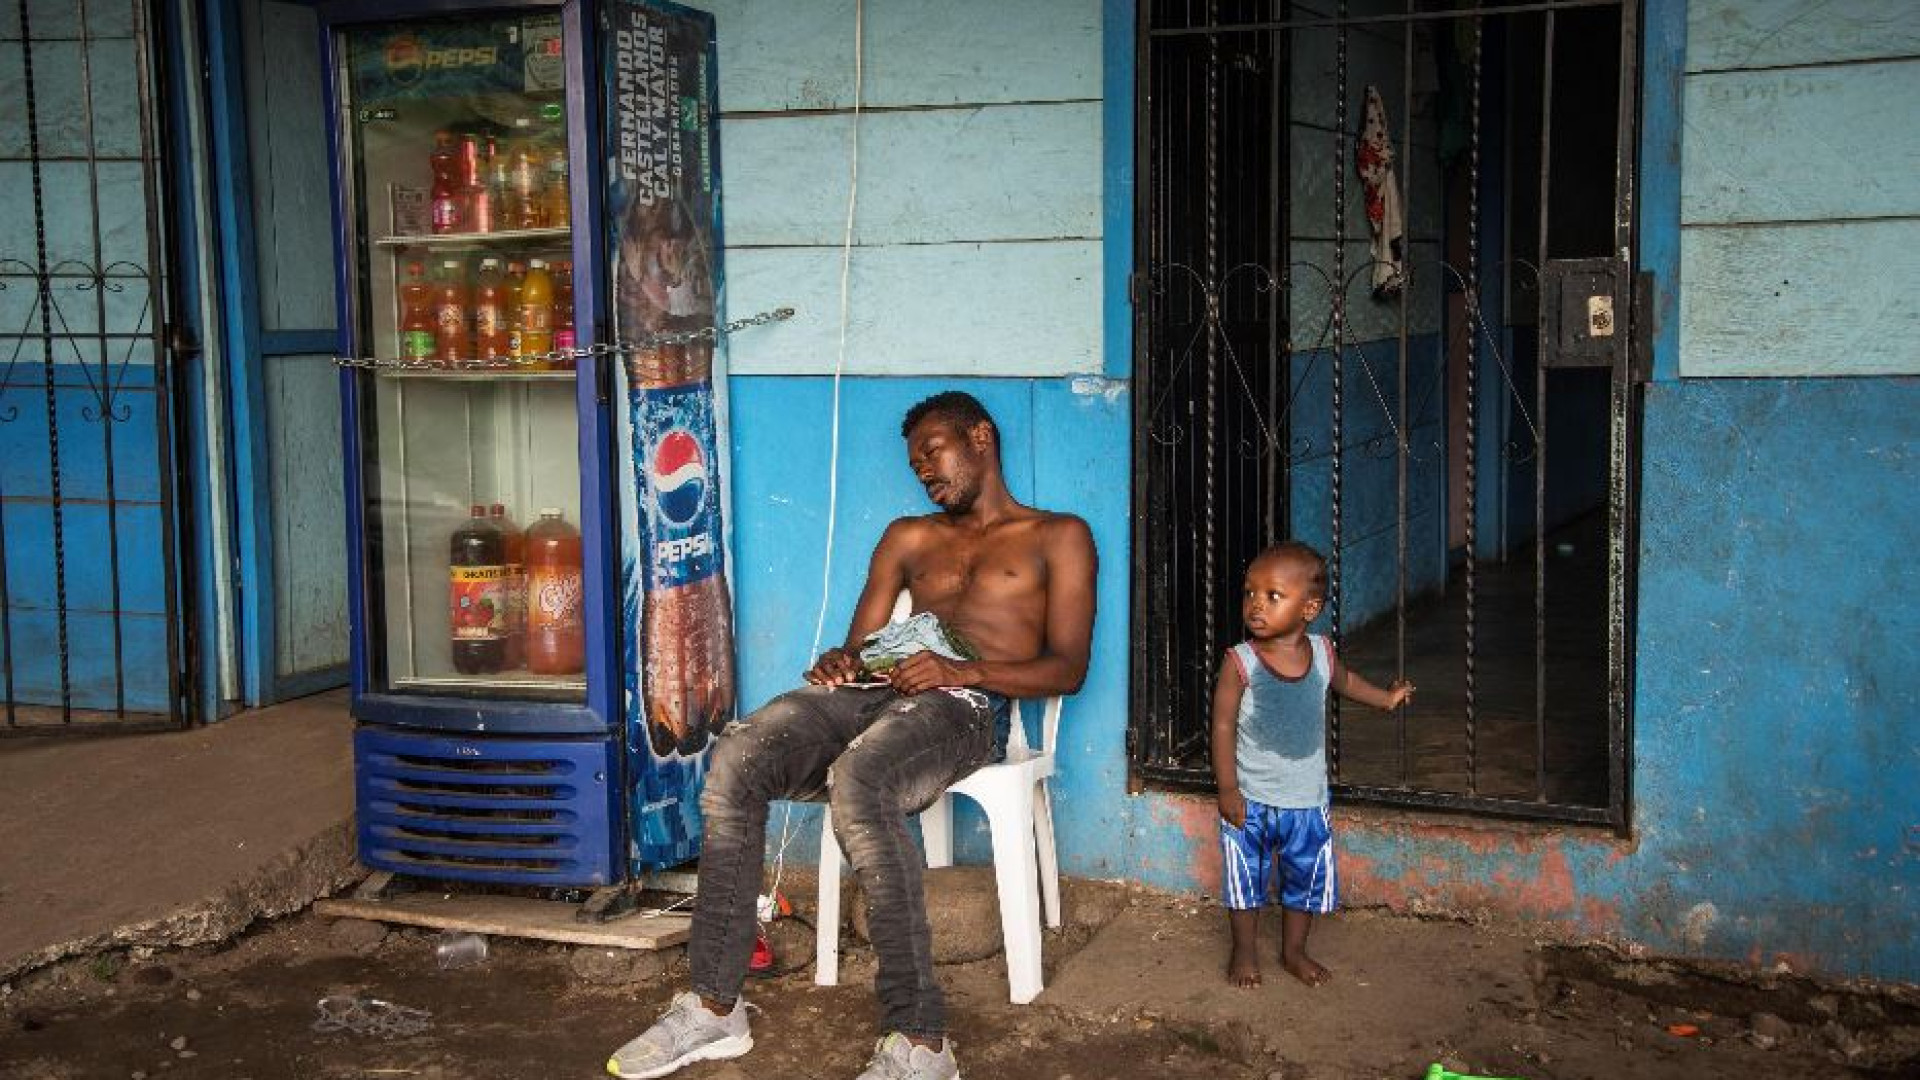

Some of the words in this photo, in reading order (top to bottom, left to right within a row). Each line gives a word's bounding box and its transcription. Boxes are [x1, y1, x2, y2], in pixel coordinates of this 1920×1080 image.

[426, 47, 496, 68] PEPSI
[649, 26, 666, 119] MAYOR
[617, 30, 636, 179] FERNANDO
[632, 11, 653, 206] CASTELLANOS
[652, 123, 667, 140] Y
[654, 147, 669, 198] CAL
[658, 533, 711, 564] PEPSI
